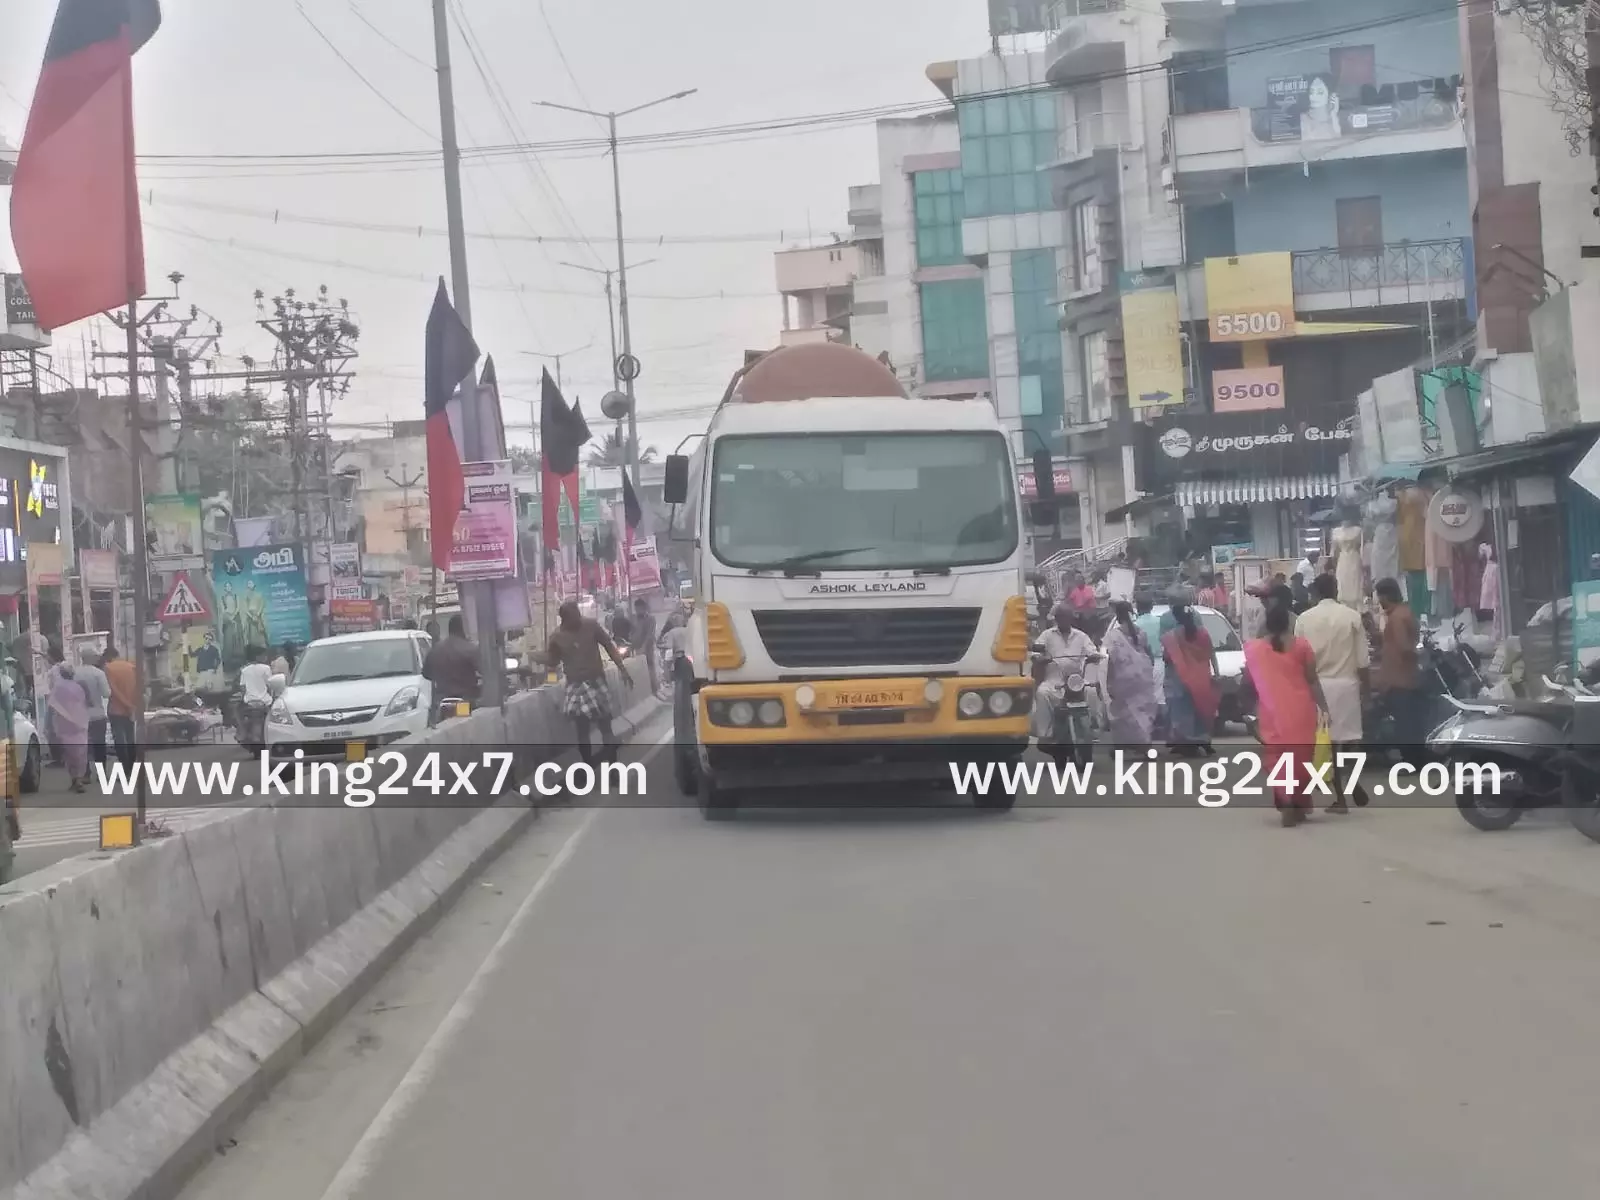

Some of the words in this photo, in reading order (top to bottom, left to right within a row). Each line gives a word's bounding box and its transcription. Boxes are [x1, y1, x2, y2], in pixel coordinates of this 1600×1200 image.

[1217, 382, 1281, 401] 9500
[809, 584, 858, 593] ASHOK
[864, 582, 927, 592] LEYLAND
